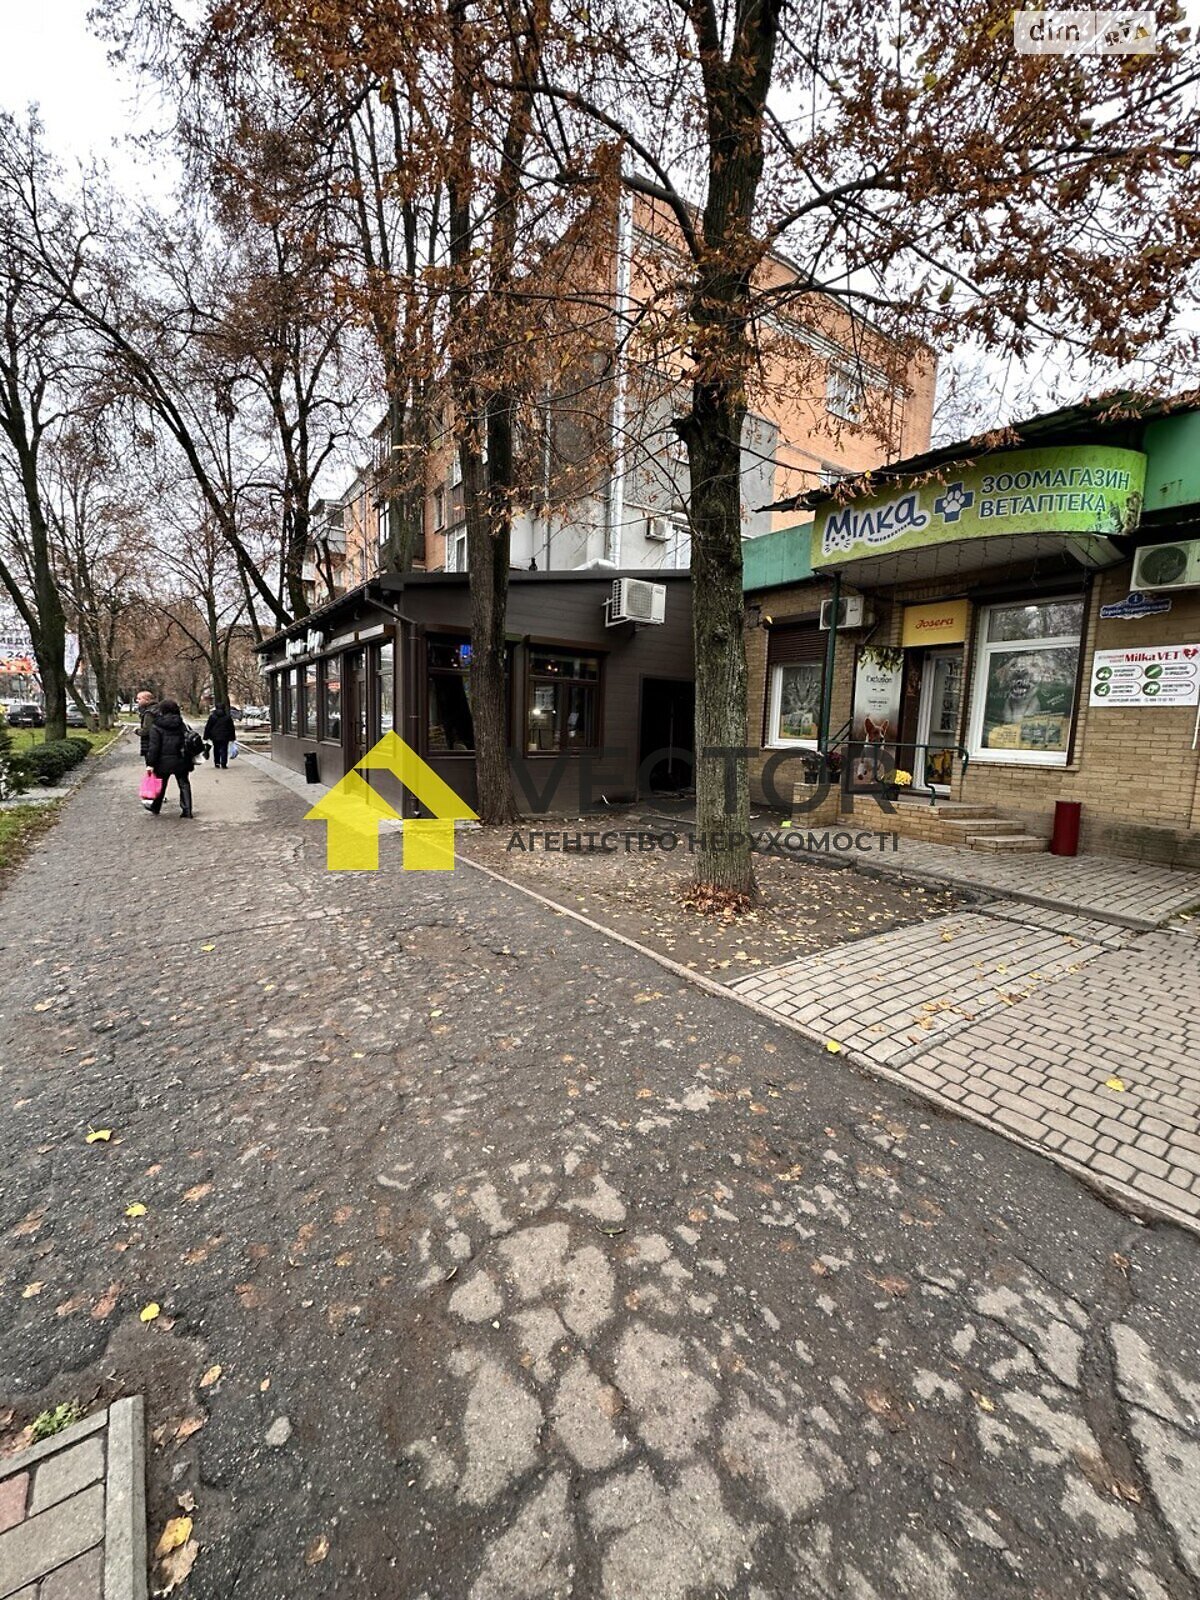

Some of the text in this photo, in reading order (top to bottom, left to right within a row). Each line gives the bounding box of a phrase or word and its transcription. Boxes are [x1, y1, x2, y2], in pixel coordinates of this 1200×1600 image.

[981, 468, 1130, 493] ЗООМАГАЗИН
[980, 494, 1106, 518] ВЕТАПТЕКА
[915, 618, 954, 629] Josera
